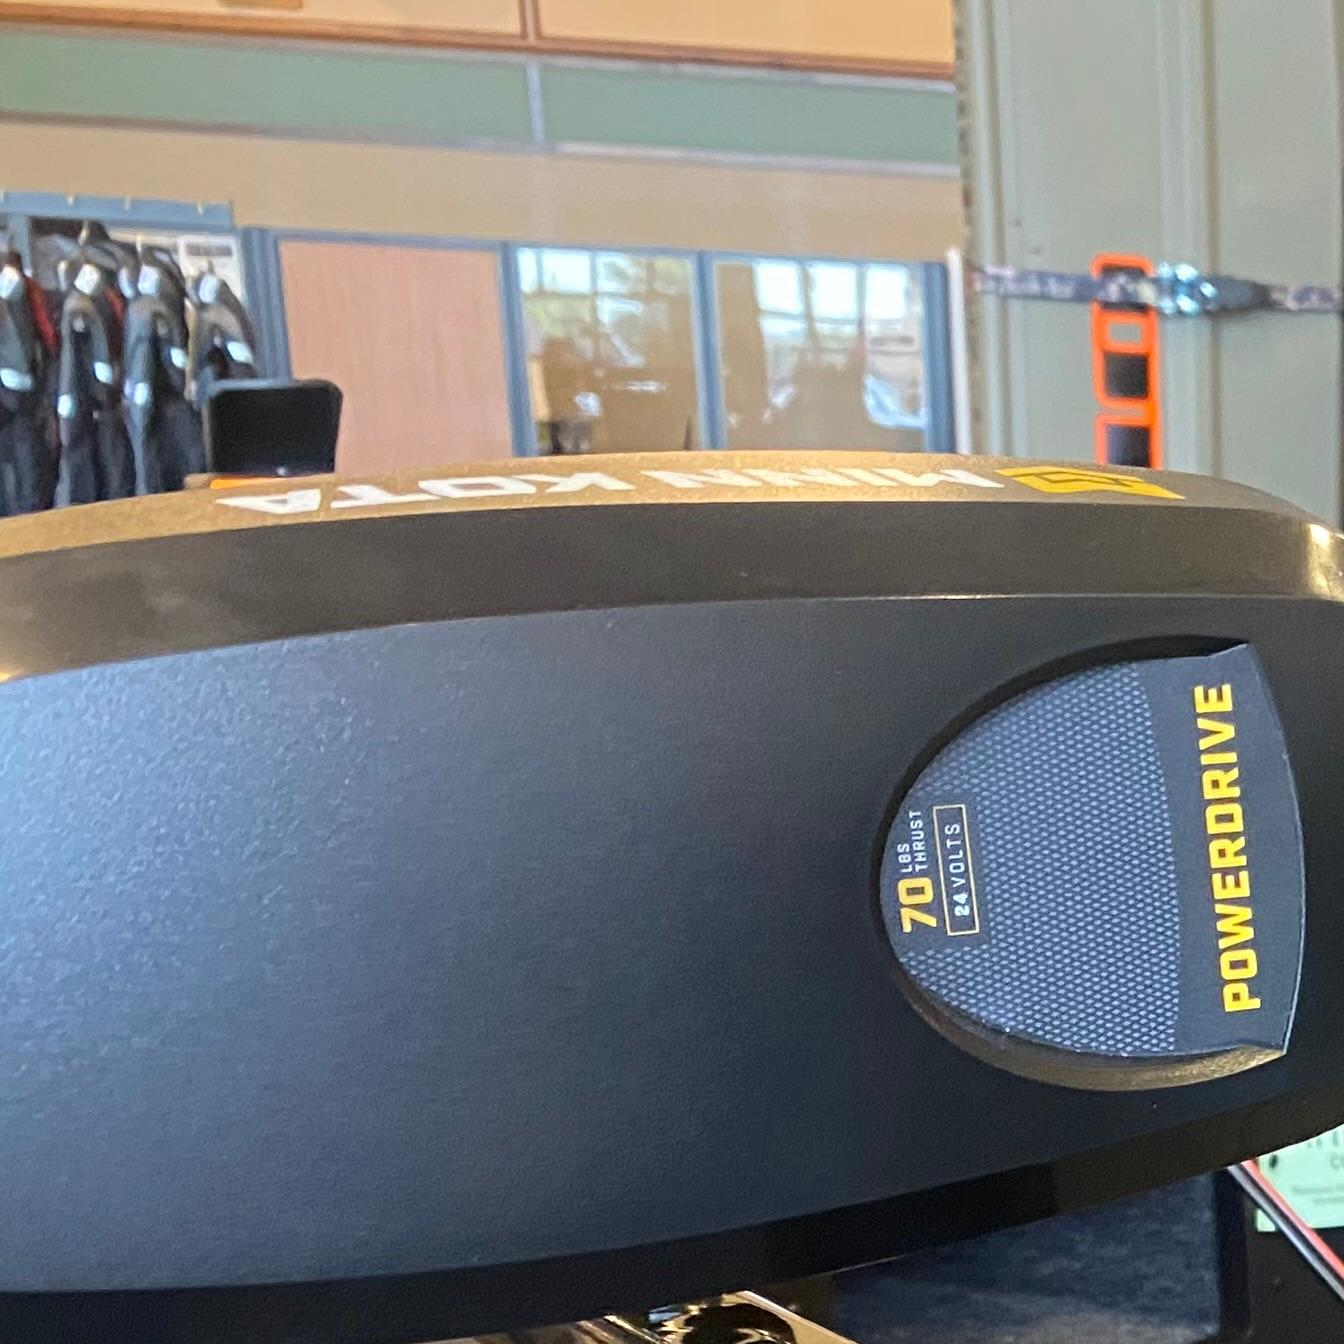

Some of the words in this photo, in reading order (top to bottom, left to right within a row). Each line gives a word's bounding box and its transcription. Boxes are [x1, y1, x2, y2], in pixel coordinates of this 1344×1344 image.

[216, 471, 636, 514] KOTA
[641, 468, 1004, 488] MINN
[897, 843, 913, 873] LBS
[909, 810, 928, 873] THRUST
[945, 823, 966, 888] VOLTS
[1193, 683, 1261, 1012] POWERDRIVE
[897, 877, 937, 933] 70
[953, 892, 970, 917] 24
